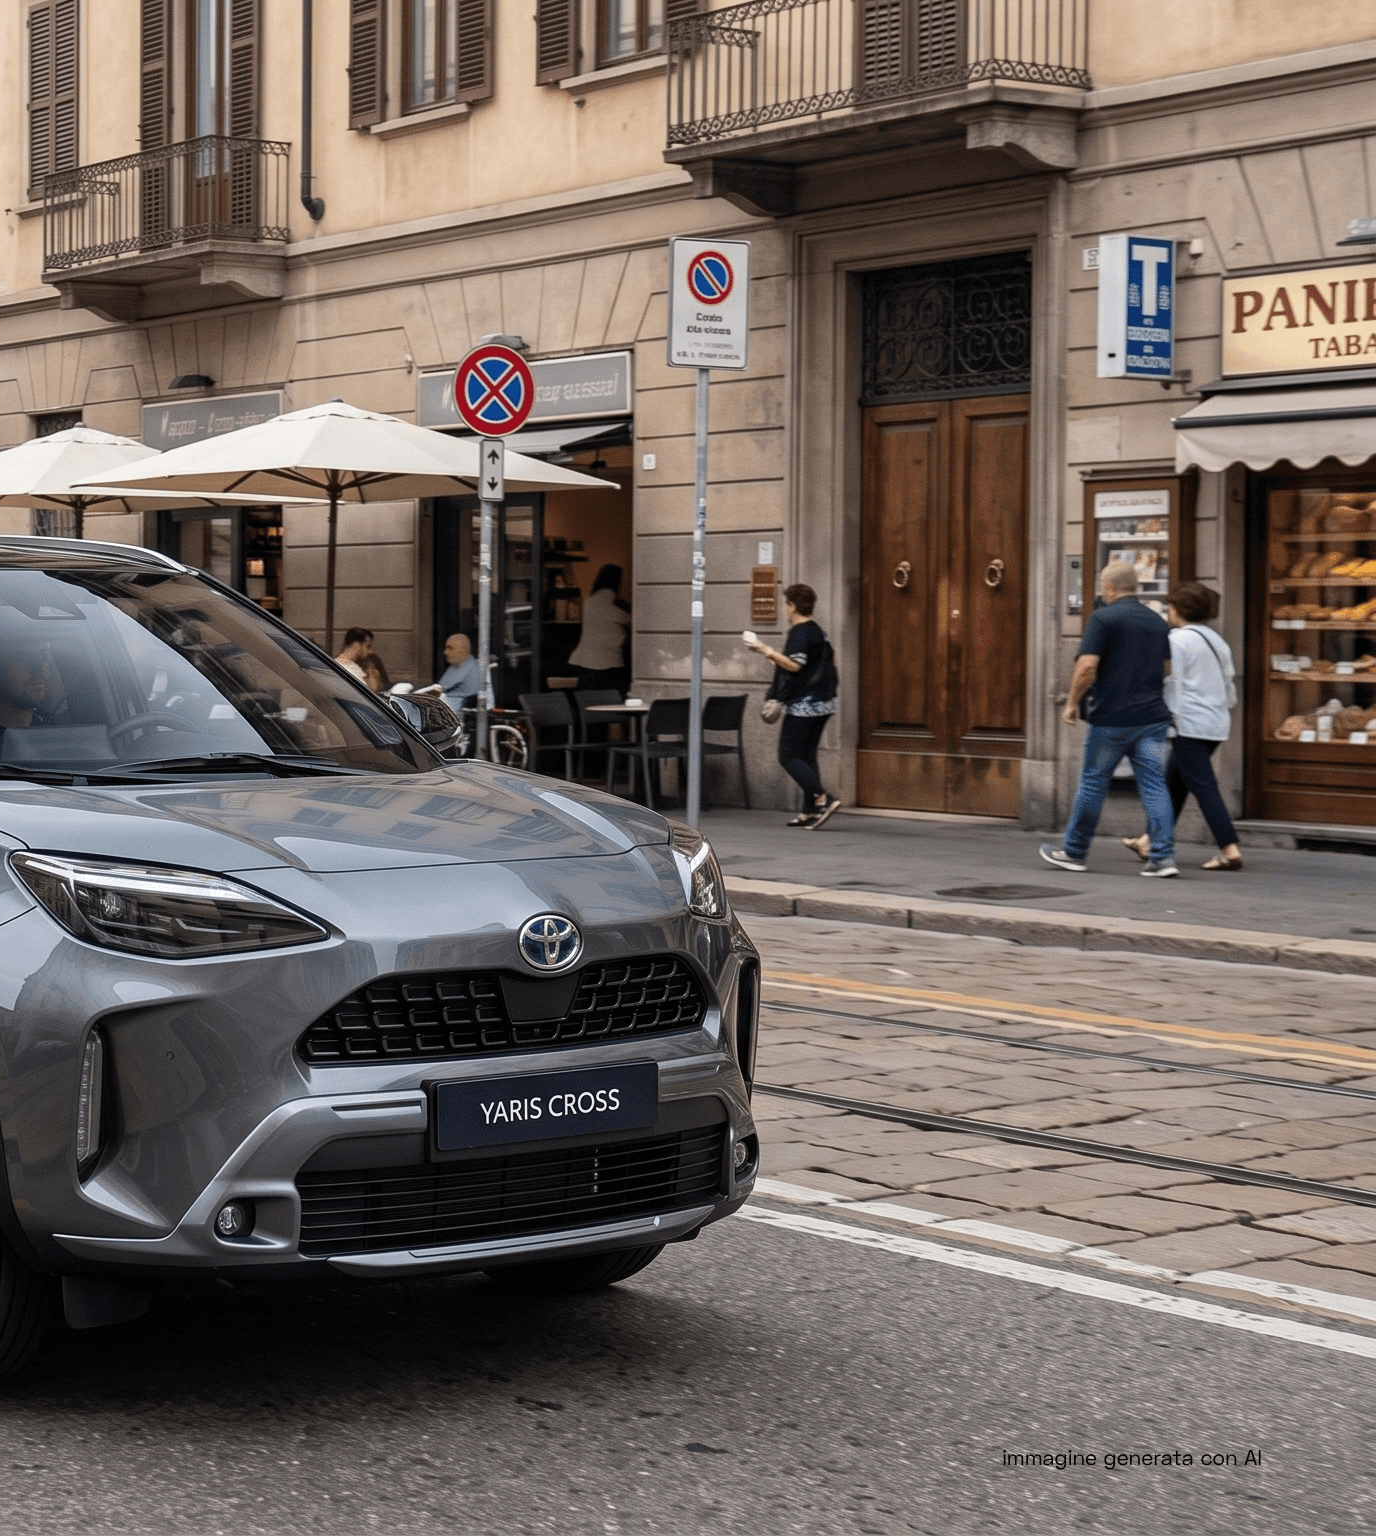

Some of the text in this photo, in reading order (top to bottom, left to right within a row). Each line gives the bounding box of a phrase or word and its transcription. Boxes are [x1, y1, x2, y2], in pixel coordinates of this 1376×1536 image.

[1308, 333, 1376, 358] TABA
[480, 1088, 620, 1125] YARIS CROSS
